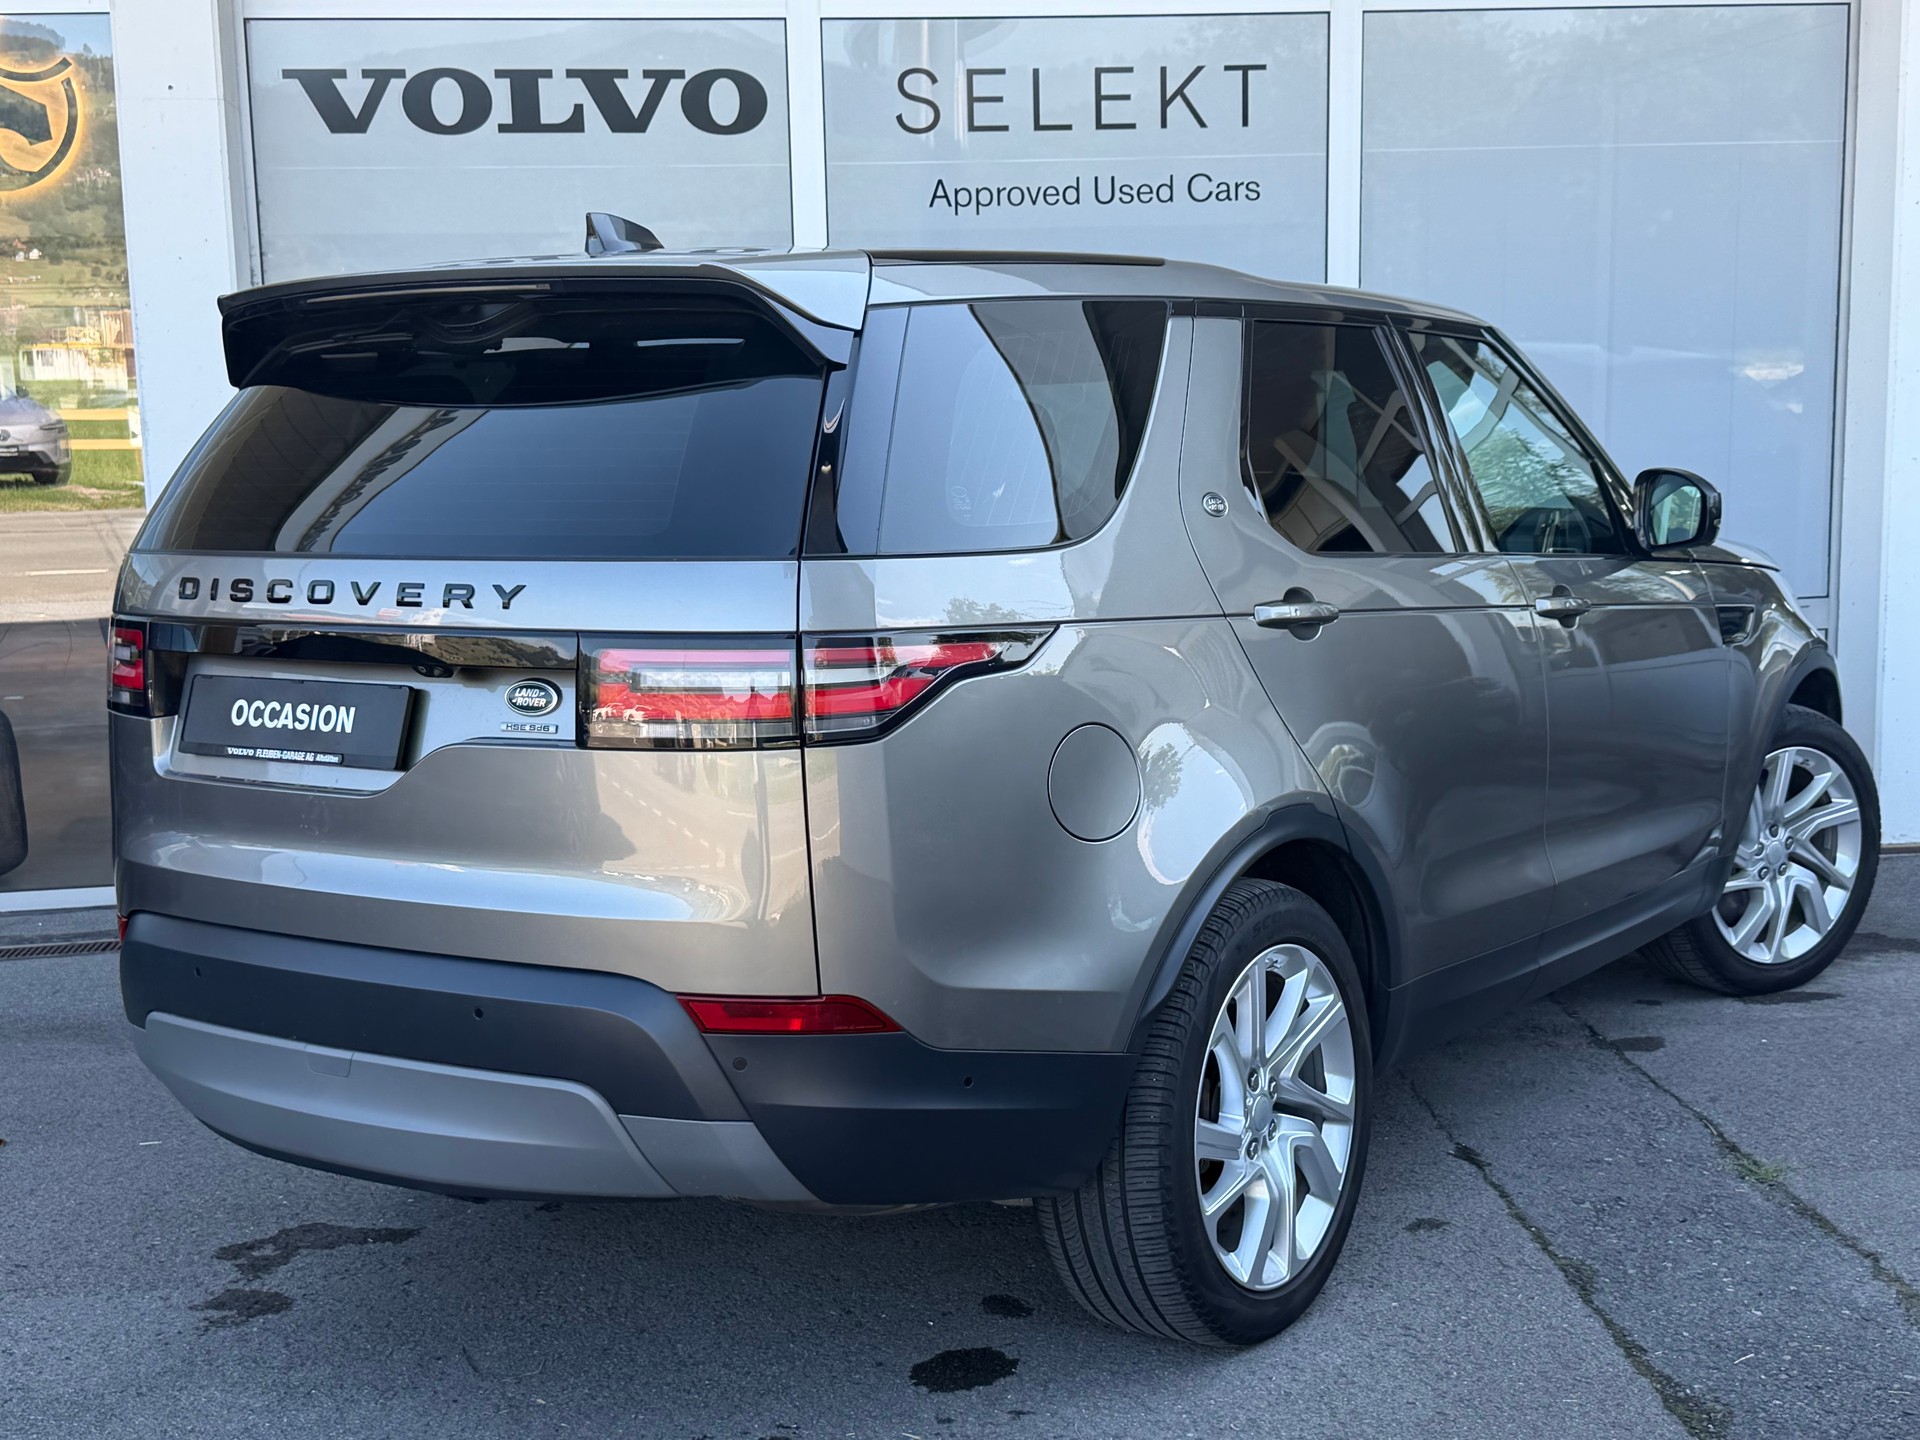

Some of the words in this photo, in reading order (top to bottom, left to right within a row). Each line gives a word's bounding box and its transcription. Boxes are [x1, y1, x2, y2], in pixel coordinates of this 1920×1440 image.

[282, 67, 768, 136] VOLVO
[896, 64, 1267, 134] SELEKT
[929, 176, 1080, 216] Approved
[1093, 175, 1174, 205] Used
[1187, 173, 1261, 204] Cars
[178, 576, 527, 609] DISCOVERY
[515, 688, 540, 698] LAND
[516, 697, 547, 707] ROVER
[231, 699, 356, 734] OCCASION
[506, 723, 527, 731] HSE
[227, 747, 255, 756] VOLVO
[305, 752, 315, 762] AG
